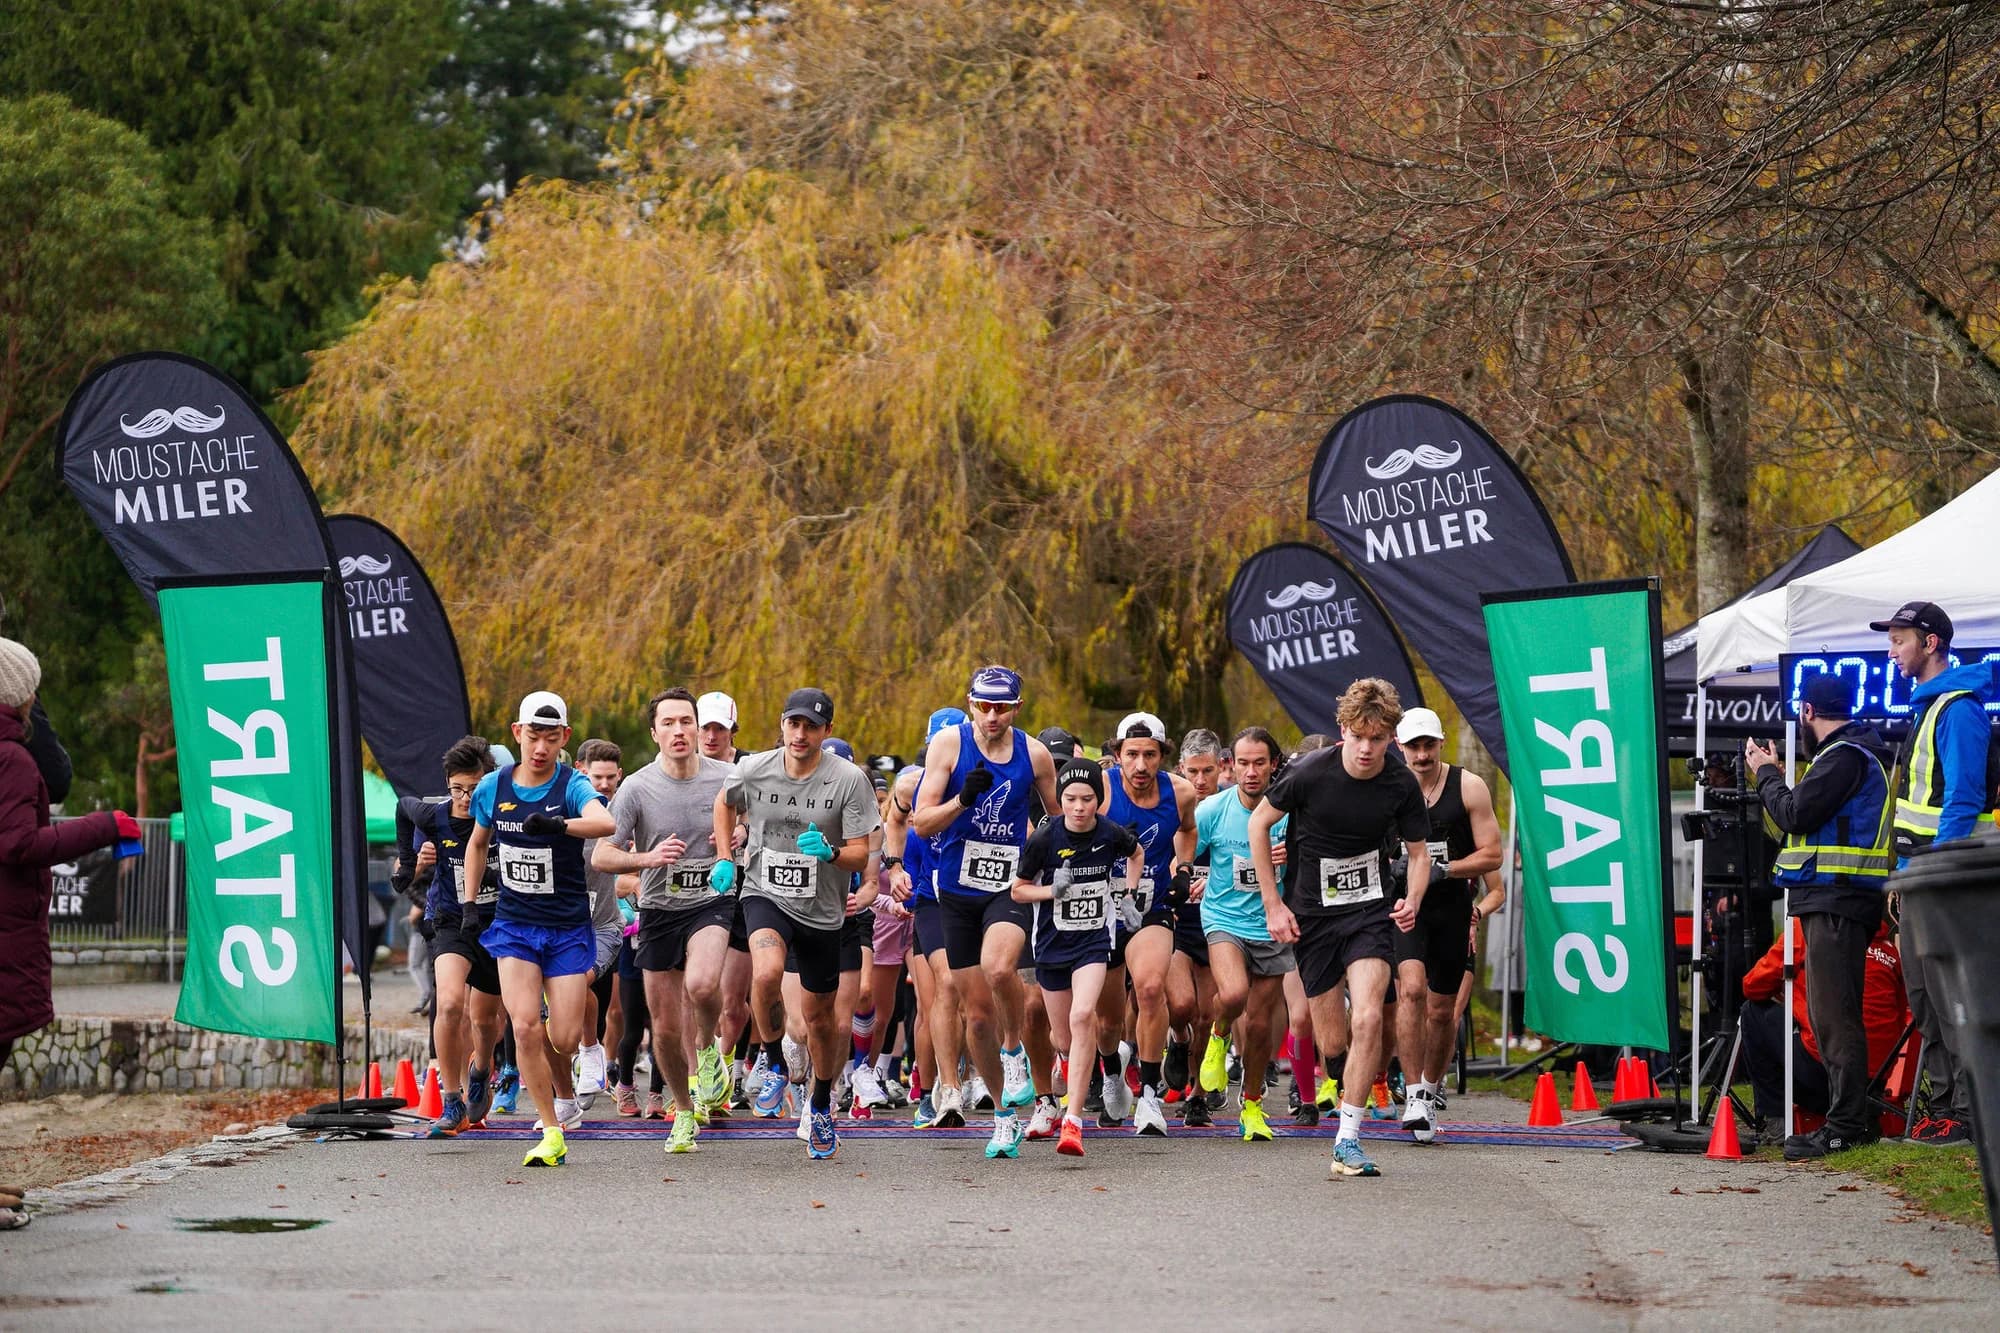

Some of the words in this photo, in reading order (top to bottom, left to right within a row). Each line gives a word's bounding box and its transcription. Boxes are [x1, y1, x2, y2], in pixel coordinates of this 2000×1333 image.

[93, 435, 259, 484] MOUSTACHE
[115, 478, 253, 524] MILER
[1342, 466, 1496, 526] MOUSTACHE
[1365, 509, 1494, 563] MILER
[343, 576, 413, 607] STACHE
[1250, 598, 1361, 643] MOUSTACHE
[1266, 629, 1360, 671] MILER
[1682, 693, 1781, 722] Involv
[1074, 769, 1090, 779] VAN
[758, 791, 834, 809] IDAHO
[979, 822, 1014, 836] VFAC
[512, 863, 539, 881] 505
[774, 867, 802, 885] 528
[976, 860, 1005, 879] 533
[682, 873, 702, 887] 114
[1336, 871, 1361, 889] 215
[49, 895, 82, 914] LER
[1069, 899, 1098, 918] 529
